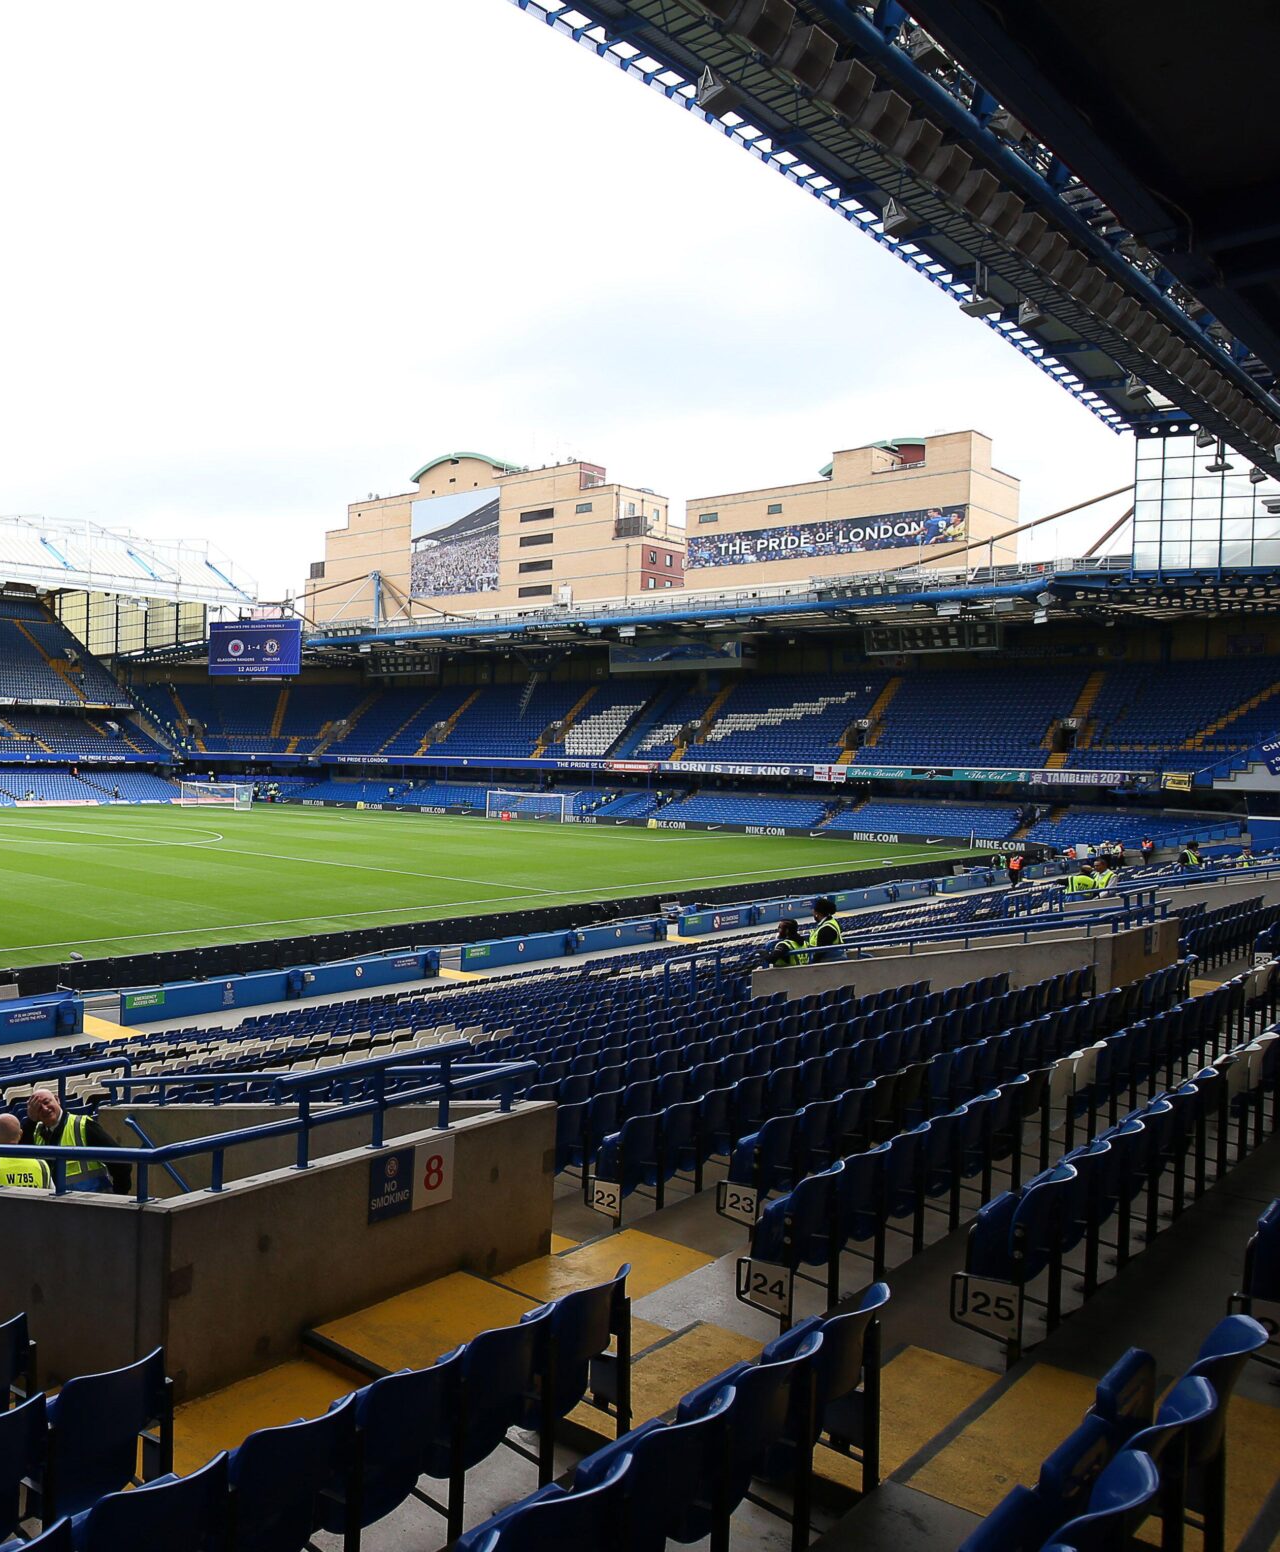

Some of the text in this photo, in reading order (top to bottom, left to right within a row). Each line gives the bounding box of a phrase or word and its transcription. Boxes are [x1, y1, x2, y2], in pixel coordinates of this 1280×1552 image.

[718, 520, 924, 556] THE PRIDE OF LONDON
[672, 762, 791, 776] BORN IS THE KING
[851, 769, 872, 777] Peter
[1046, 772, 1121, 785] TAMBLING 202
[420, 806, 446, 814] NIKE.COM
[745, 825, 786, 837] NIKE.COM
[853, 832, 899, 843] NIKE.COM
[975, 839, 1026, 851] NIKE.COM
[6, 1173, 34, 1184] W 785
[423, 1154, 444, 1191] 8
[384, 1180, 398, 1194] NO
[370, 1189, 410, 1210] SMOKING
[595, 1190, 617, 1210] 22
[728, 1193, 754, 1214] 23
[753, 1272, 787, 1300] 24
[971, 1290, 1015, 1321] 25
